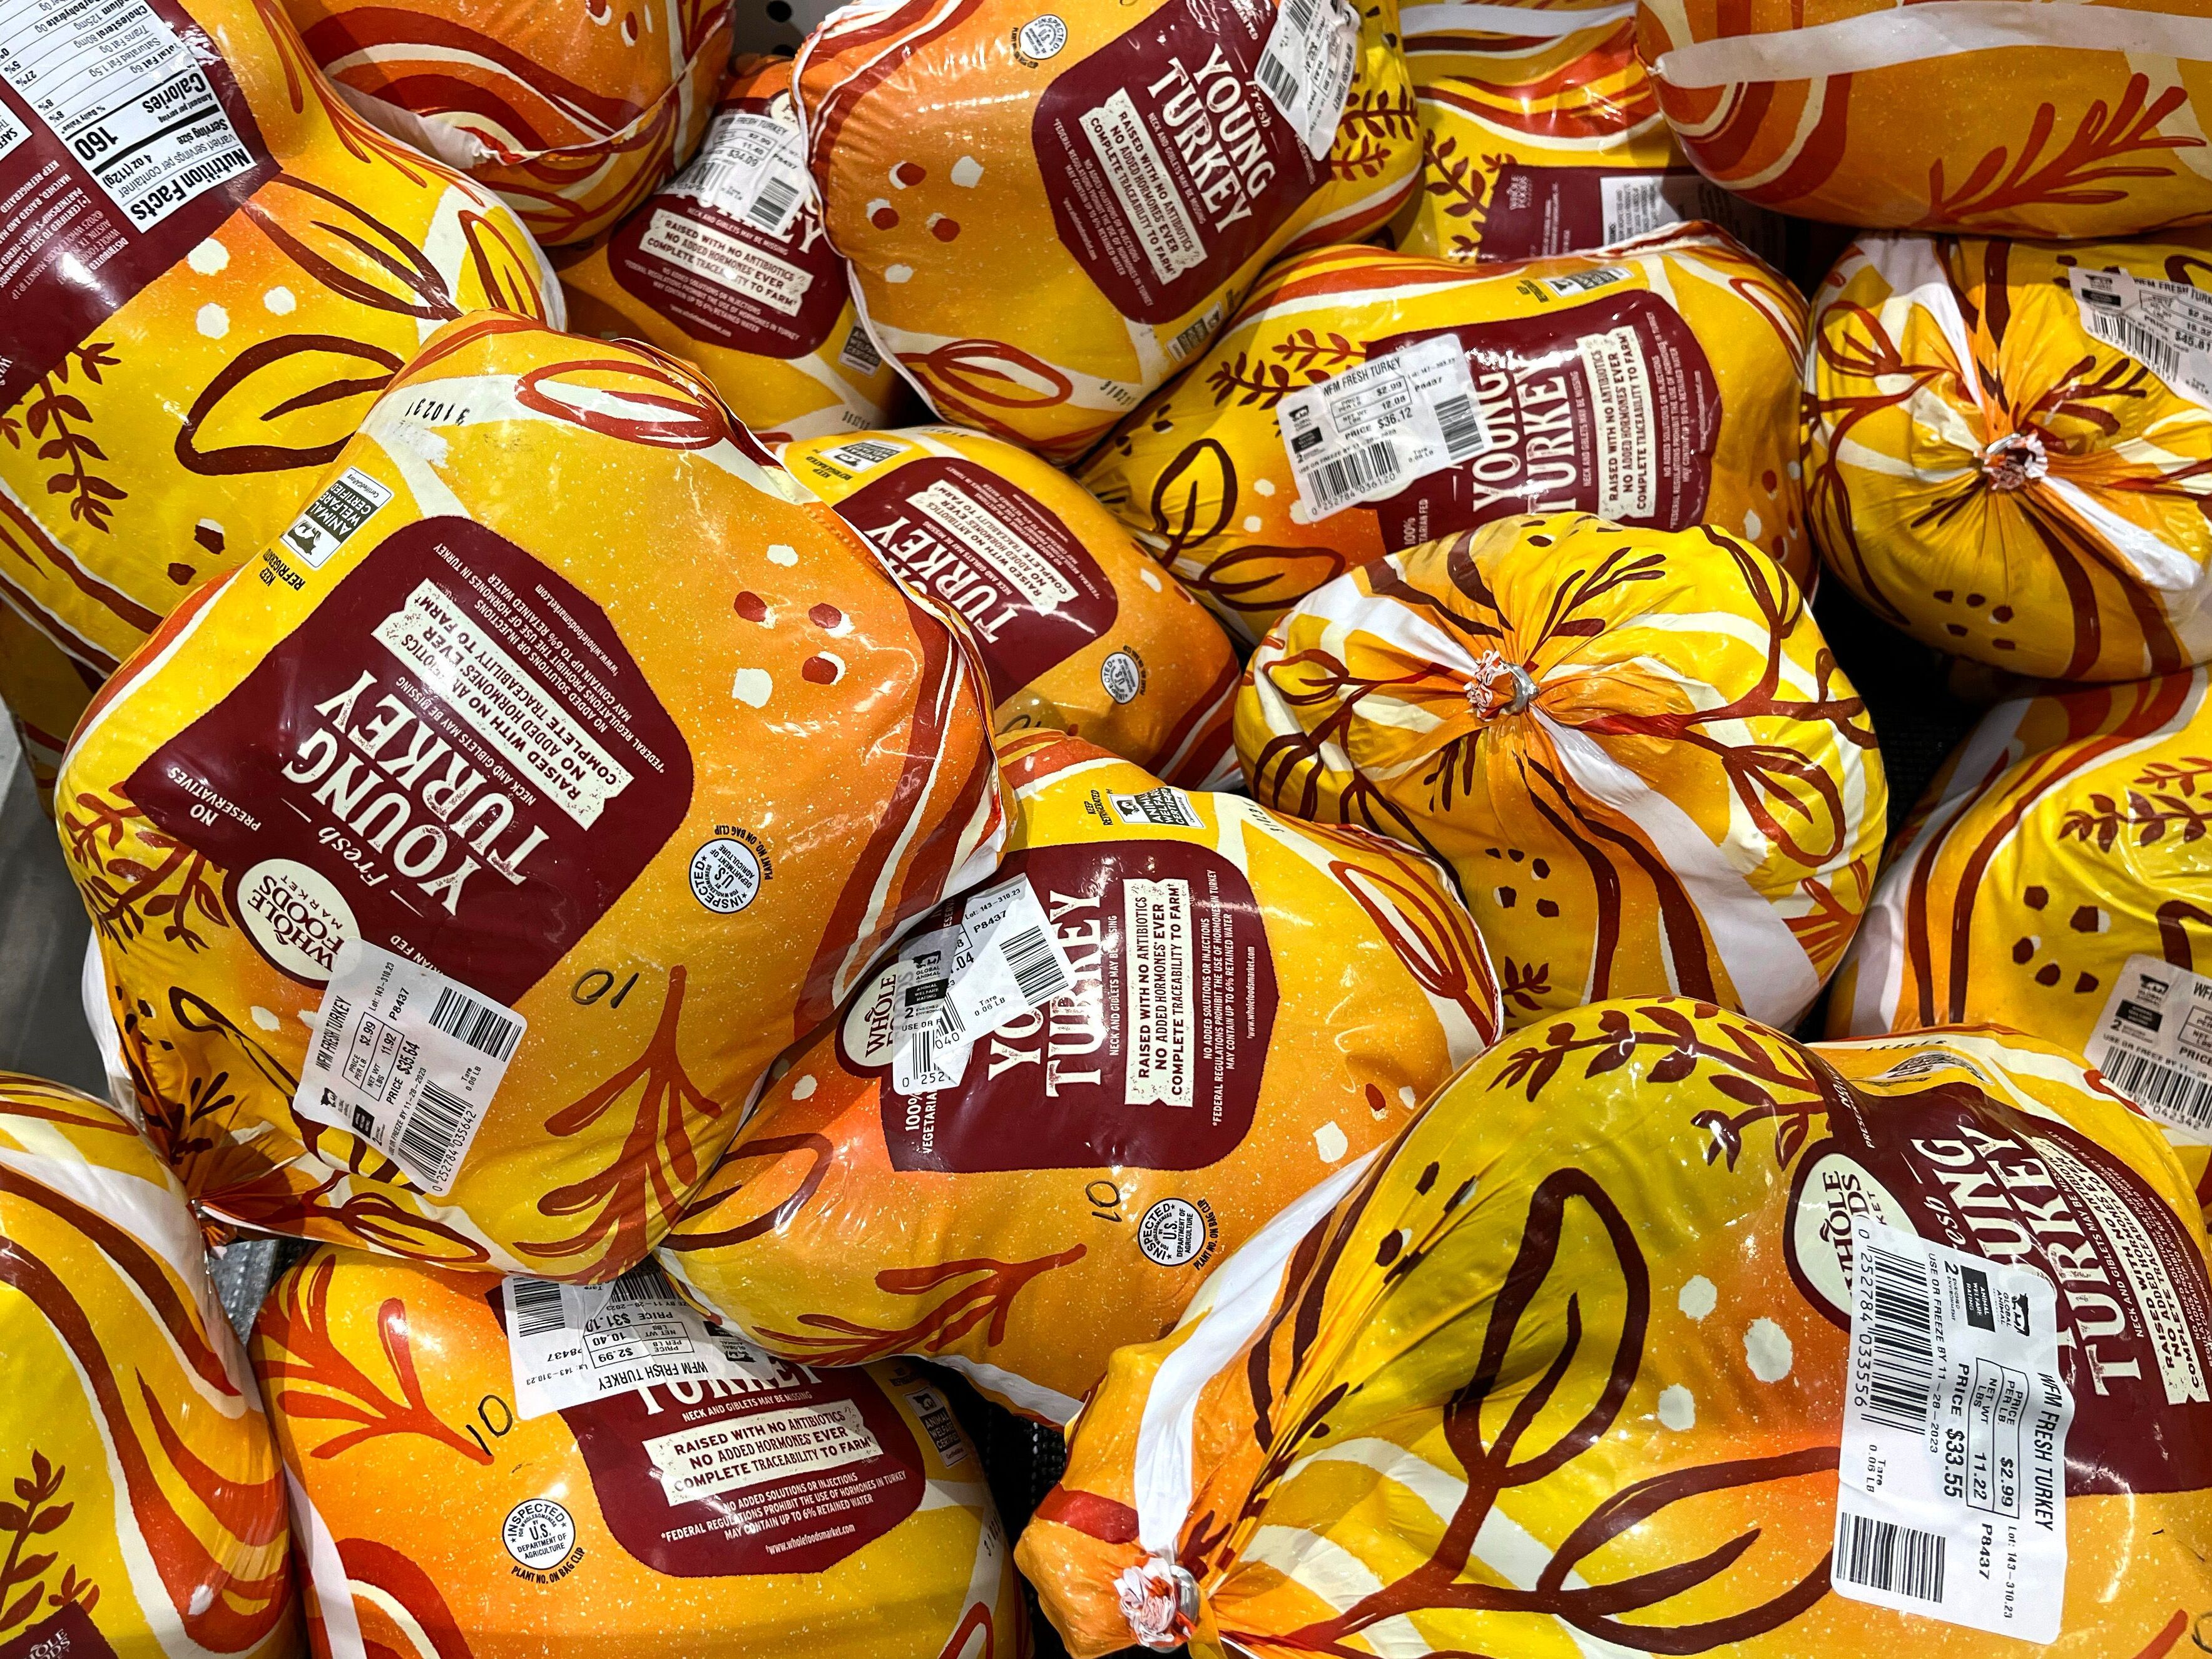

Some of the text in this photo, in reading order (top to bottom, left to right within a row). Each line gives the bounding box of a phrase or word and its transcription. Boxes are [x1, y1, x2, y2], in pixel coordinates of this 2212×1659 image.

[95, 3, 147, 39] Cholesterol
[14, 69, 37, 87] 27%
[88, 36, 161, 79] Saturated Fat 1.5g
[72, 70, 206, 163] Calories 160
[1193, 43, 1277, 200] YOUNG
[101, 116, 227, 189] Serving size 4 oz (112g)
[159, 156, 176, 174] per
[171, 140, 208, 167] servings
[1147, 56, 1257, 233] TURKEY
[0, 159, 59, 213] KEEP REFRIGERATED
[116, 165, 162, 198] container
[128, 146, 250, 224] Nutrition Facts
[1117, 111, 1195, 252] RAISED WITH NO ANTIBIOTICS
[700, 234, 726, 251] WITH
[1342, 357, 1401, 387] FRESH TURKEY
[1377, 407, 1413, 429] $36.12
[309, 500, 351, 537] ANIMAL
[320, 491, 362, 526] WELFARE
[330, 481, 372, 516] CERTIFIED
[257, 566, 278, 586] KEEP
[864, 515, 1018, 643] TURKEY
[984, 544, 1042, 598] RAISED WITH
[1022, 551, 1069, 595] COMPLETE
[474, 598, 608, 733] NO ADDED SOLUTIONS OR INJECTIONS
[487, 572, 632, 722] MAY CONTAIN UP TO 6% RETAINED WATER
[455, 630, 619, 786] COMPLETE TRACEABILITY TO
[394, 675, 537, 806] NECK AND GIBLETS MAY BE MISSING
[466, 694, 581, 800] RAISED WITH NO
[167, 767, 261, 831] PRESERVATIVES
[317, 668, 550, 884] TURKEY
[188, 800, 218, 828] NO
[281, 728, 481, 917] YOUNG
[315, 826, 389, 887] Fresh
[715, 864, 734, 889] U.S.
[279, 873, 344, 931] MARKET
[694, 860, 743, 909] INSPECTED
[246, 889, 336, 972] WHOLE
[261, 875, 345, 954] FOODS
[972, 909, 1008, 933] P8437
[388, 986, 410, 1021] P8437
[1135, 897, 1153, 1078] RAISED WITH NO ANTIBIOTICS
[313, 995, 352, 1071] WFM FRESH TURKEY
[359, 1020, 379, 1047] $2.99
[380, 1033, 397, 1056] 11.92
[1154, 1004, 1169, 1070] NO ADDED
[385, 1039, 421, 1105] PRICE $35.64
[437, 1110, 477, 1182] 252784 035642
[1143, 1203, 1170, 1260] INSPECTED
[1163, 1220, 1178, 1240] U.S.
[1176, 1208, 1185, 1257] DEPARTMENT OF
[1185, 1213, 1193, 1253] AGRICULTURE
[1956, 1124, 2142, 1397] TURKEY
[586, 1310, 672, 1332] PRICE $31.10
[1853, 1253, 1872, 1407] 252784 033556
[1928, 1254, 1947, 1362] USE OR FREEZE BY
[592, 1331, 625, 1345] 10.40
[598, 1347, 634, 1362] $2.99
[598, 1361, 708, 1390] WFM TURKEY
[2001, 1380, 2016, 1404] PER
[466, 1395, 512, 1456] 10
[1979, 1377, 1997, 1425] NET WT
[2006, 1390, 2023, 1426] PRICE
[674, 1410, 845, 1456] RAISED WITH NO ANTIBIOTICS
[690, 1426, 847, 1469] NO ADDED EVER
[1941, 1363, 1970, 1498] PRICE $33.55
[1972, 1385, 1988, 1499] LBS 11.22
[2031, 1376, 2061, 1530] WFM FRESH TURKEY
[1998, 1457, 2014, 1507] $2.99
[508, 1503, 564, 1536] INSPECTED
[517, 1533, 567, 1553] DEPARTMENT OF
[529, 1523, 551, 1540] U.S.
[511, 1547, 585, 1584] PLANT NO. ON BAG CLIP
[524, 1543, 566, 1559] AGRICULTURE
[1979, 1523, 1991, 1579] P8437
